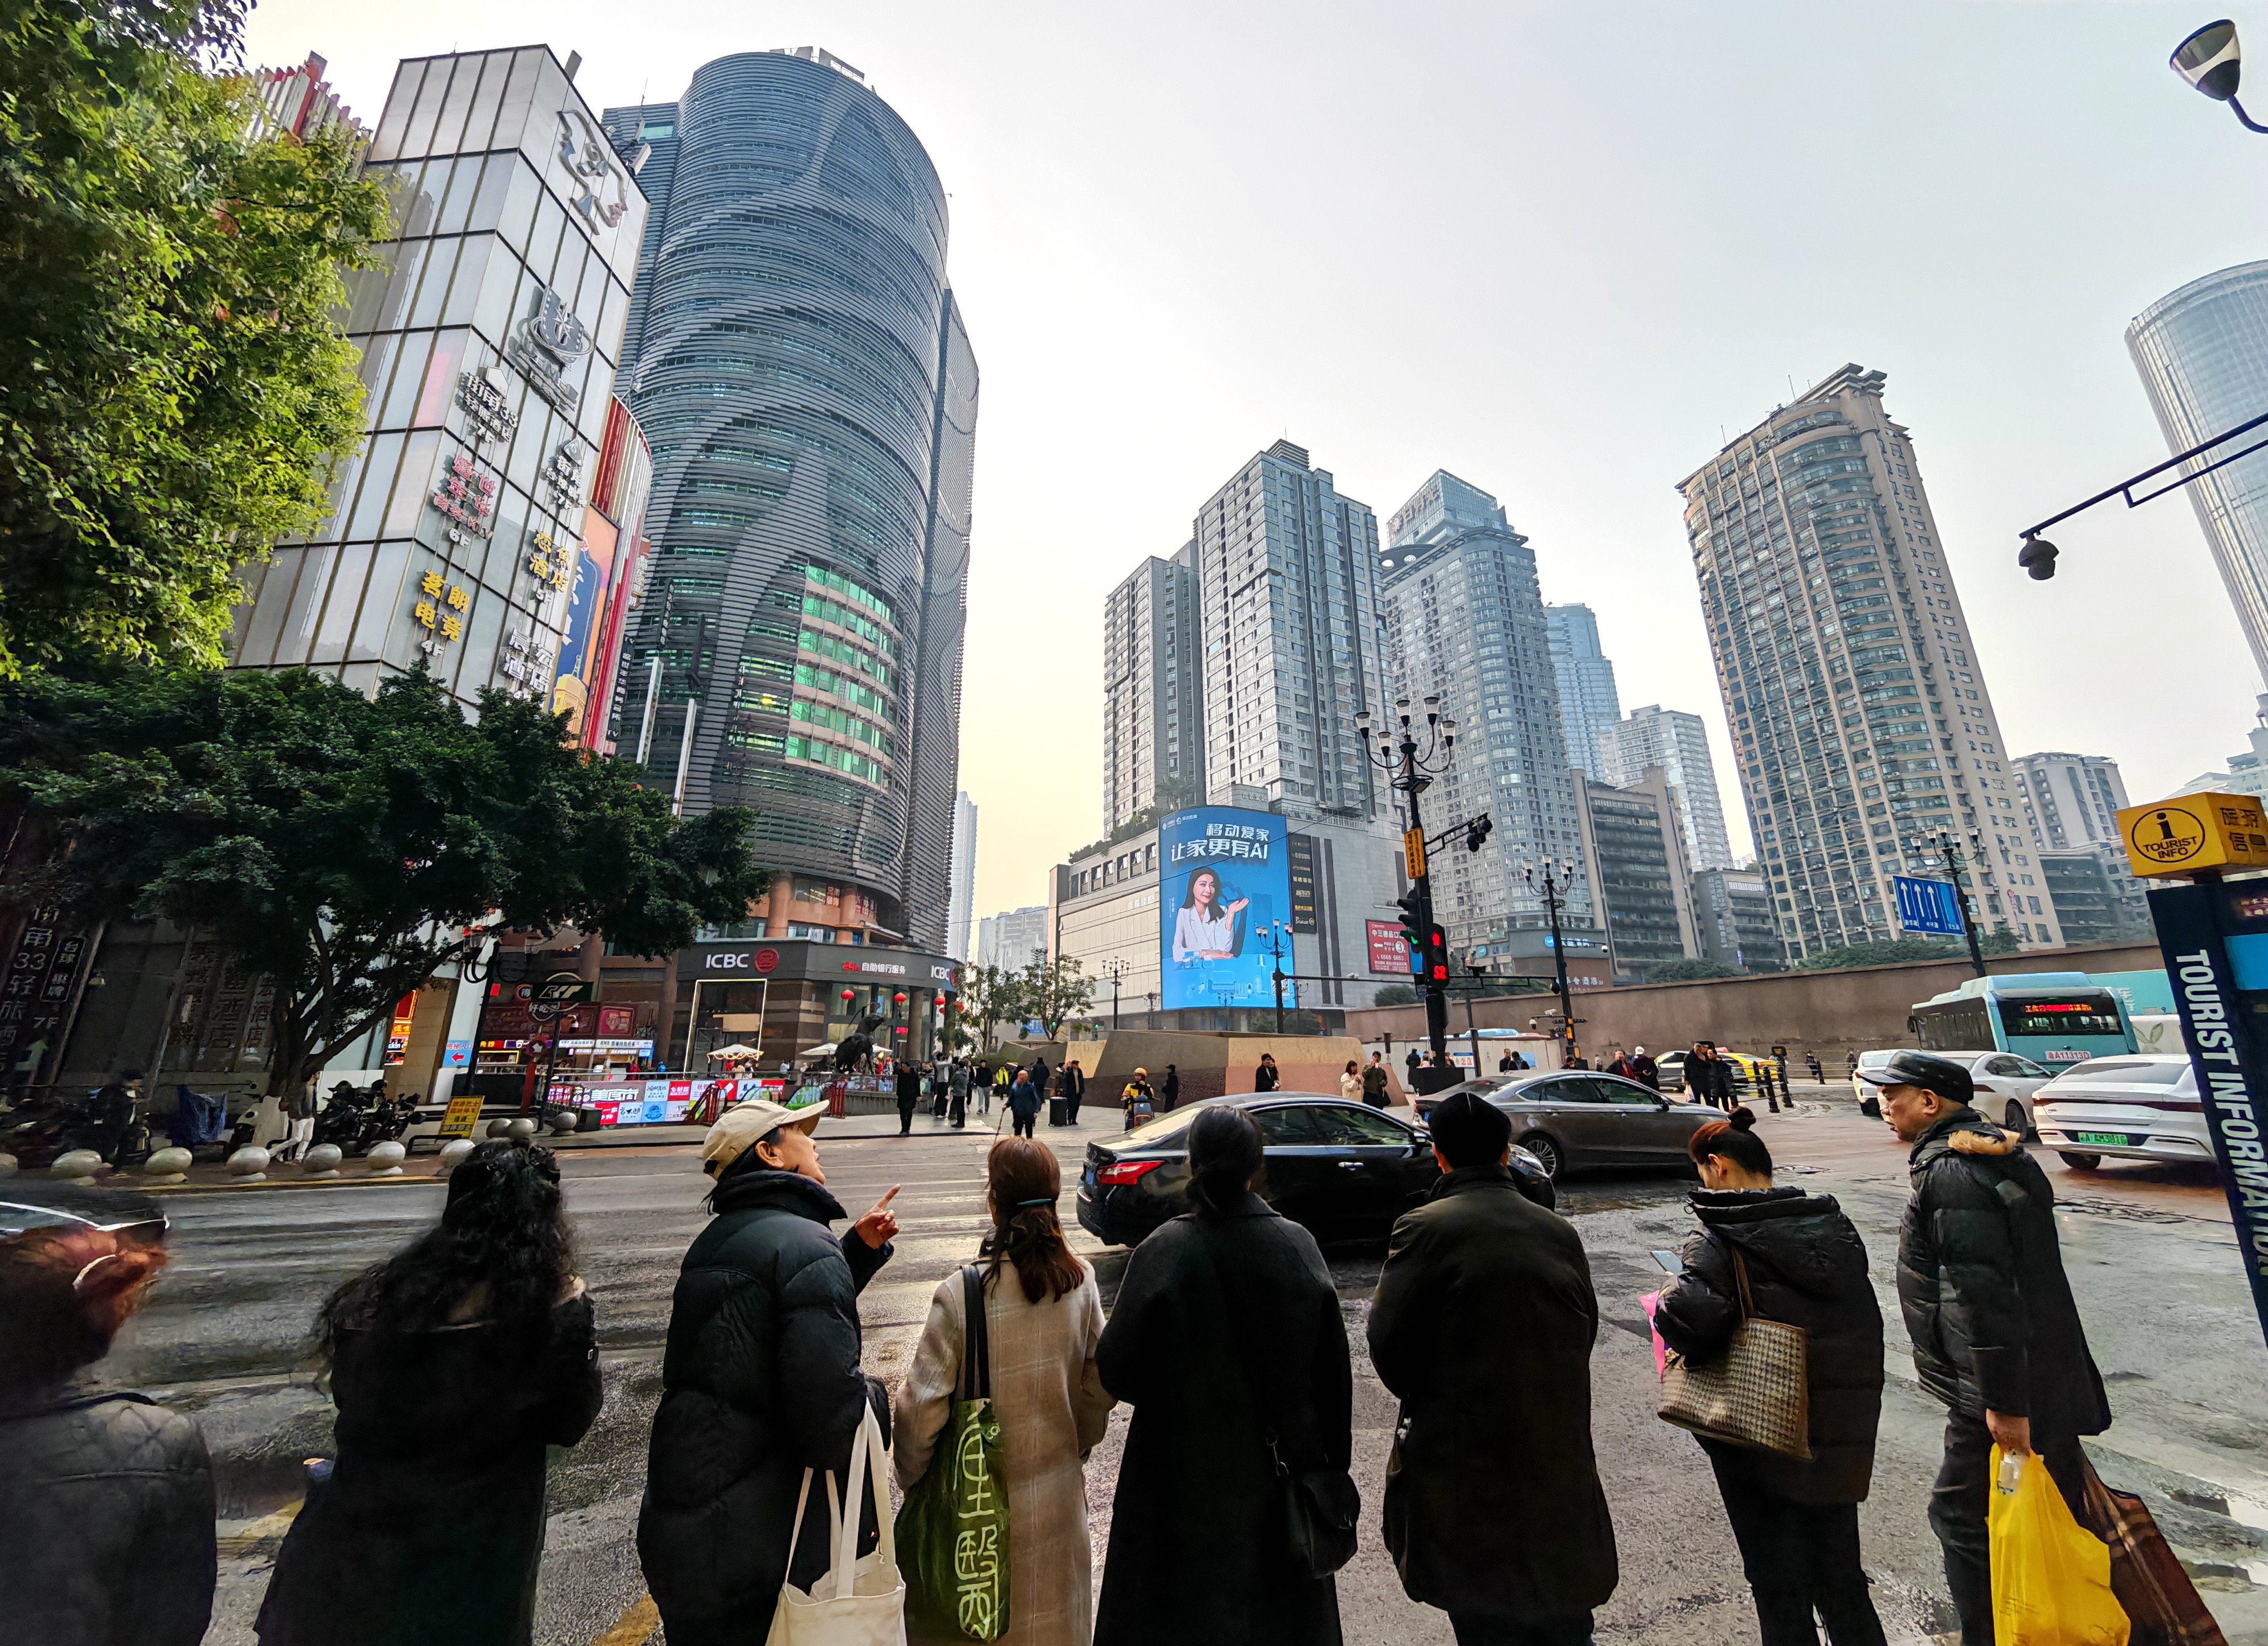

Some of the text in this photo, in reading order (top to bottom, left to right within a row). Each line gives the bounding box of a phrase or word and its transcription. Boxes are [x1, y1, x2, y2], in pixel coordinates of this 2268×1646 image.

[477, 423, 495, 444] 7F
[449, 529, 471, 547] 6F
[415, 601, 462, 642] 电竞
[421, 640, 445, 657] 4F
[1205, 823, 1270, 842] 移动爱家
[1171, 838, 1268, 862] 让家更有AI
[2143, 836, 2199, 853] TOURIST
[2157, 846, 2189, 860] INFO
[705, 953, 750, 969] ICBC
[861, 963, 906, 975] 自助银行服务
[930, 965, 951, 981] ICBC
[2176, 949, 2240, 1066] TOURIST
[34, 1017, 59, 1029] 7F
